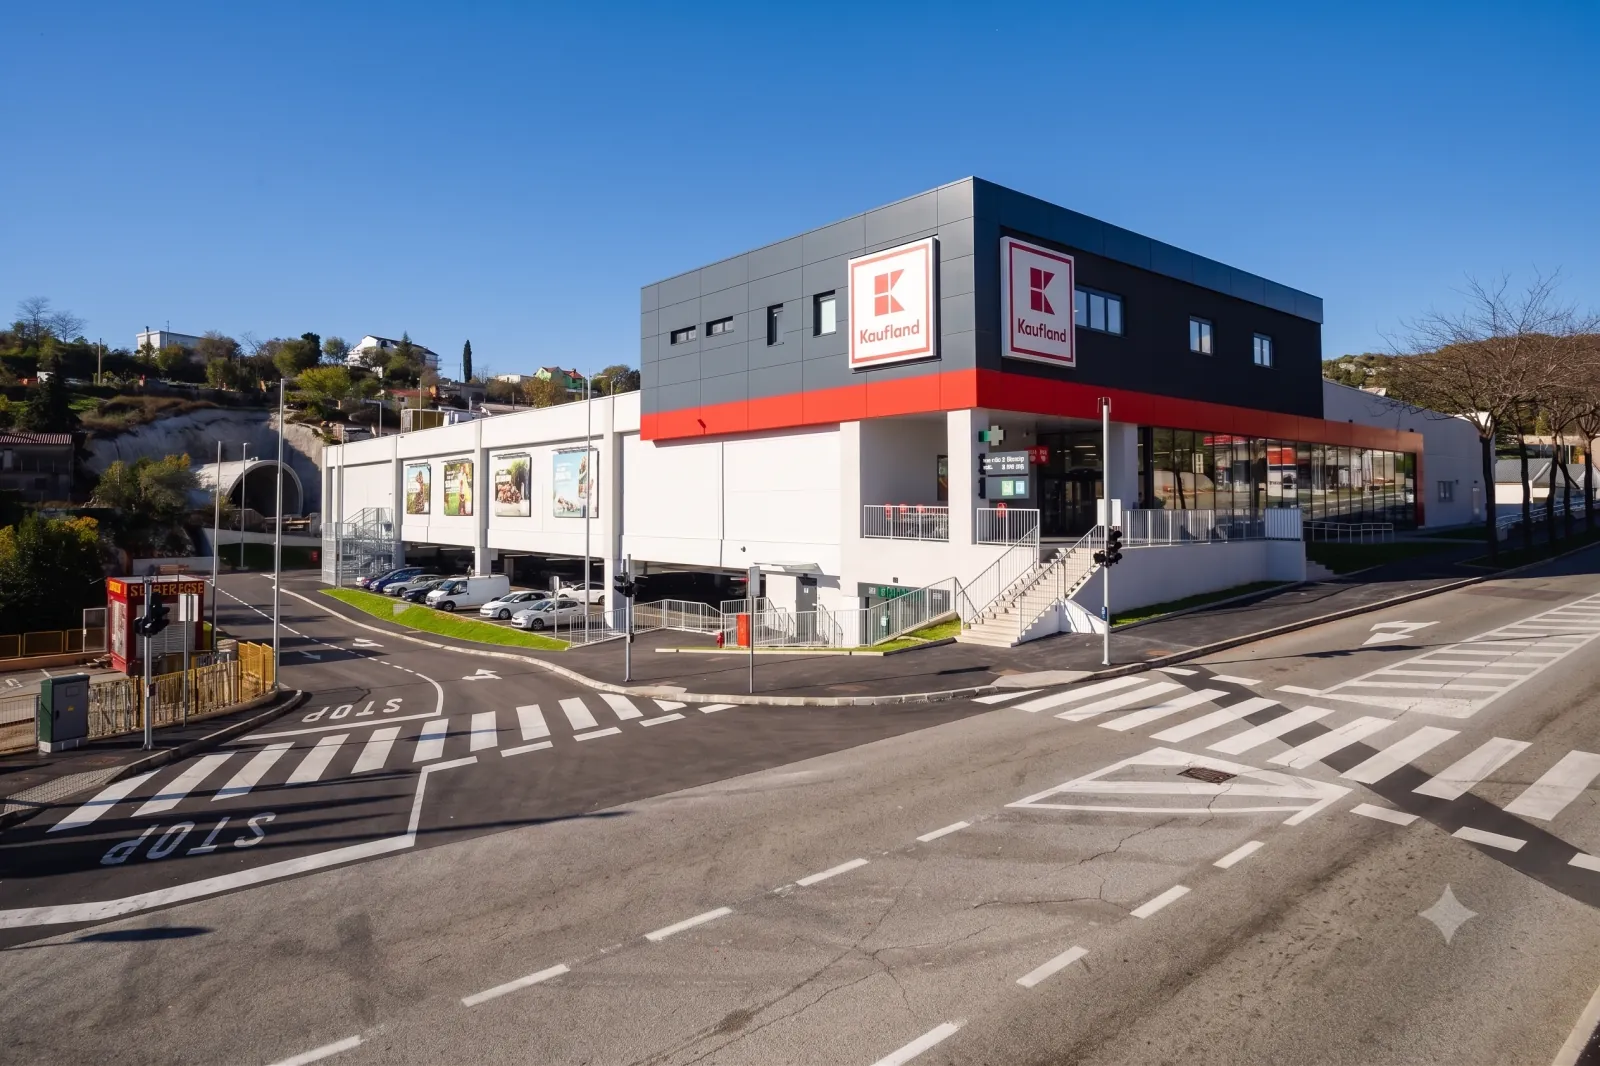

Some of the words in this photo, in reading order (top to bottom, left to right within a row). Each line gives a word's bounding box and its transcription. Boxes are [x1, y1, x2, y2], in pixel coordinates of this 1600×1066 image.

[860, 319, 920, 344] Kaufland
[1018, 318, 1067, 343] Kaufland
[301, 698, 403, 722] STOP
[100, 812, 276, 865] STOP
